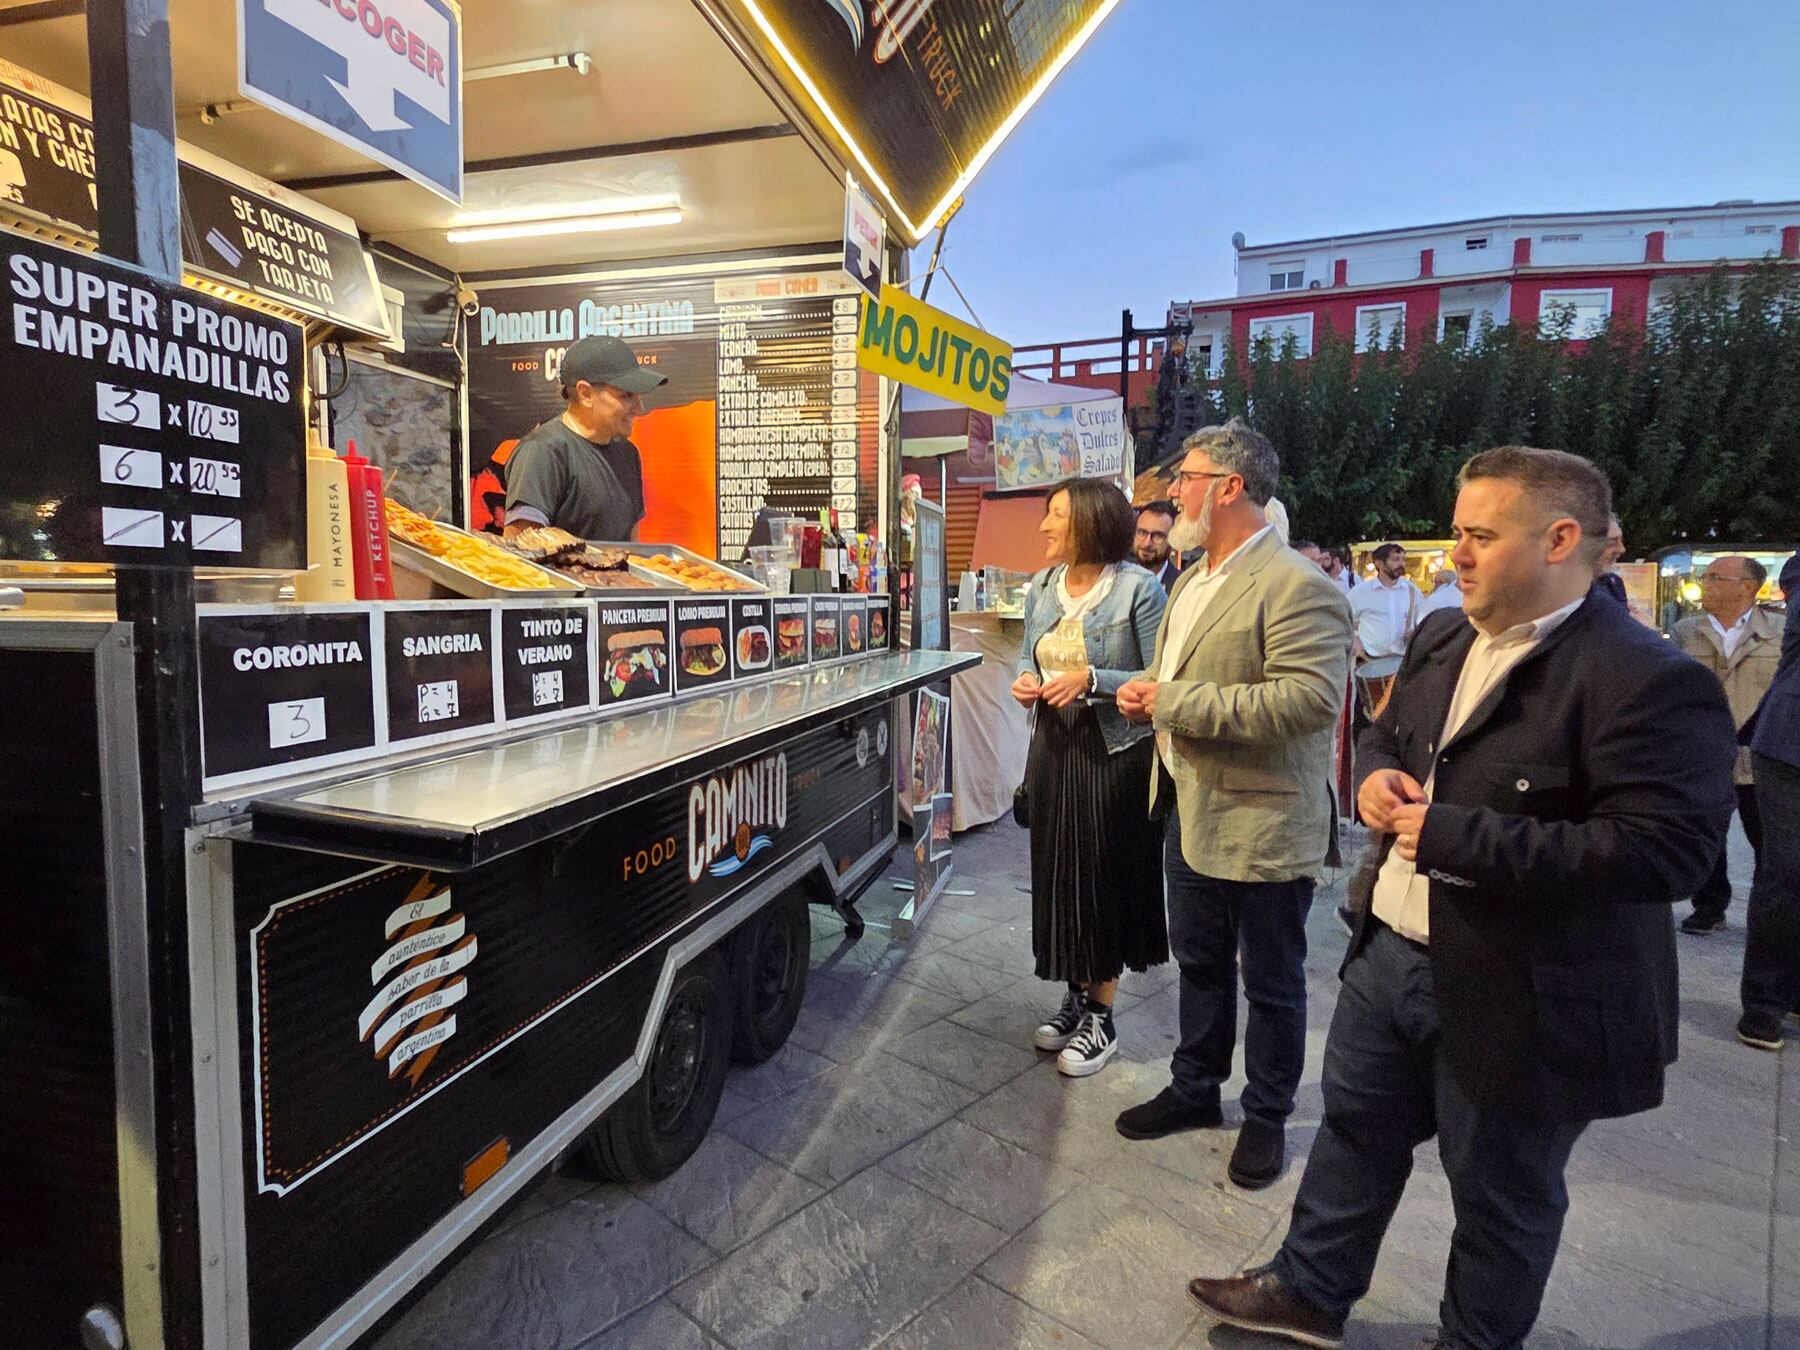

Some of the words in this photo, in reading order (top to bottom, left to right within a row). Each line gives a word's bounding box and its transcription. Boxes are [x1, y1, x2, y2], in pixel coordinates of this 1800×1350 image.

[318, 0, 445, 88] COGER
[916, 22, 962, 112] TRUCK
[0, 94, 66, 142] ATAS
[23, 128, 40, 158] Y
[47, 139, 96, 178] CHE
[230, 195, 258, 225] SE
[260, 208, 328, 254] ACEPTA
[241, 226, 294, 265] PAGO
[297, 249, 333, 280] CON
[258, 259, 335, 304] TARJETA
[9, 254, 158, 331] SUPER
[171, 298, 289, 366] PROMO
[481, 307, 574, 345] PARRILLA
[579, 299, 694, 339] ARGENTINA
[13, 303, 290, 403] EMPANADILLAS
[512, 362, 539, 371] FOOD
[863, 299, 1012, 401] MOJITOS
[105, 386, 141, 426] 3
[1077, 408, 1117, 427] Crepes
[1080, 431, 1119, 450] Dulces
[115, 451, 136, 481] 6
[329, 482, 343, 567] MAYONESA
[366, 490, 383, 561] KETCHUP
[521, 619, 563, 638] TINTO
[564, 618, 583, 634] DE
[602, 608, 636, 625] PANCETA
[637, 608, 667, 623] PREMIUM
[678, 606, 698, 621] LOMO
[232, 640, 363, 672] CORONITA
[403, 633, 483, 658] SANGRIA
[517, 644, 573, 665] VERANO
[287, 704, 311, 739] 3
[688, 751, 788, 881] CAMINITO
[623, 837, 675, 881] FOOD
[409, 902, 425, 920] El
[424, 964, 438, 980] de
[439, 958, 450, 974] la
[399, 993, 443, 1027] parrilla
[397, 1026, 446, 1061] argentina
